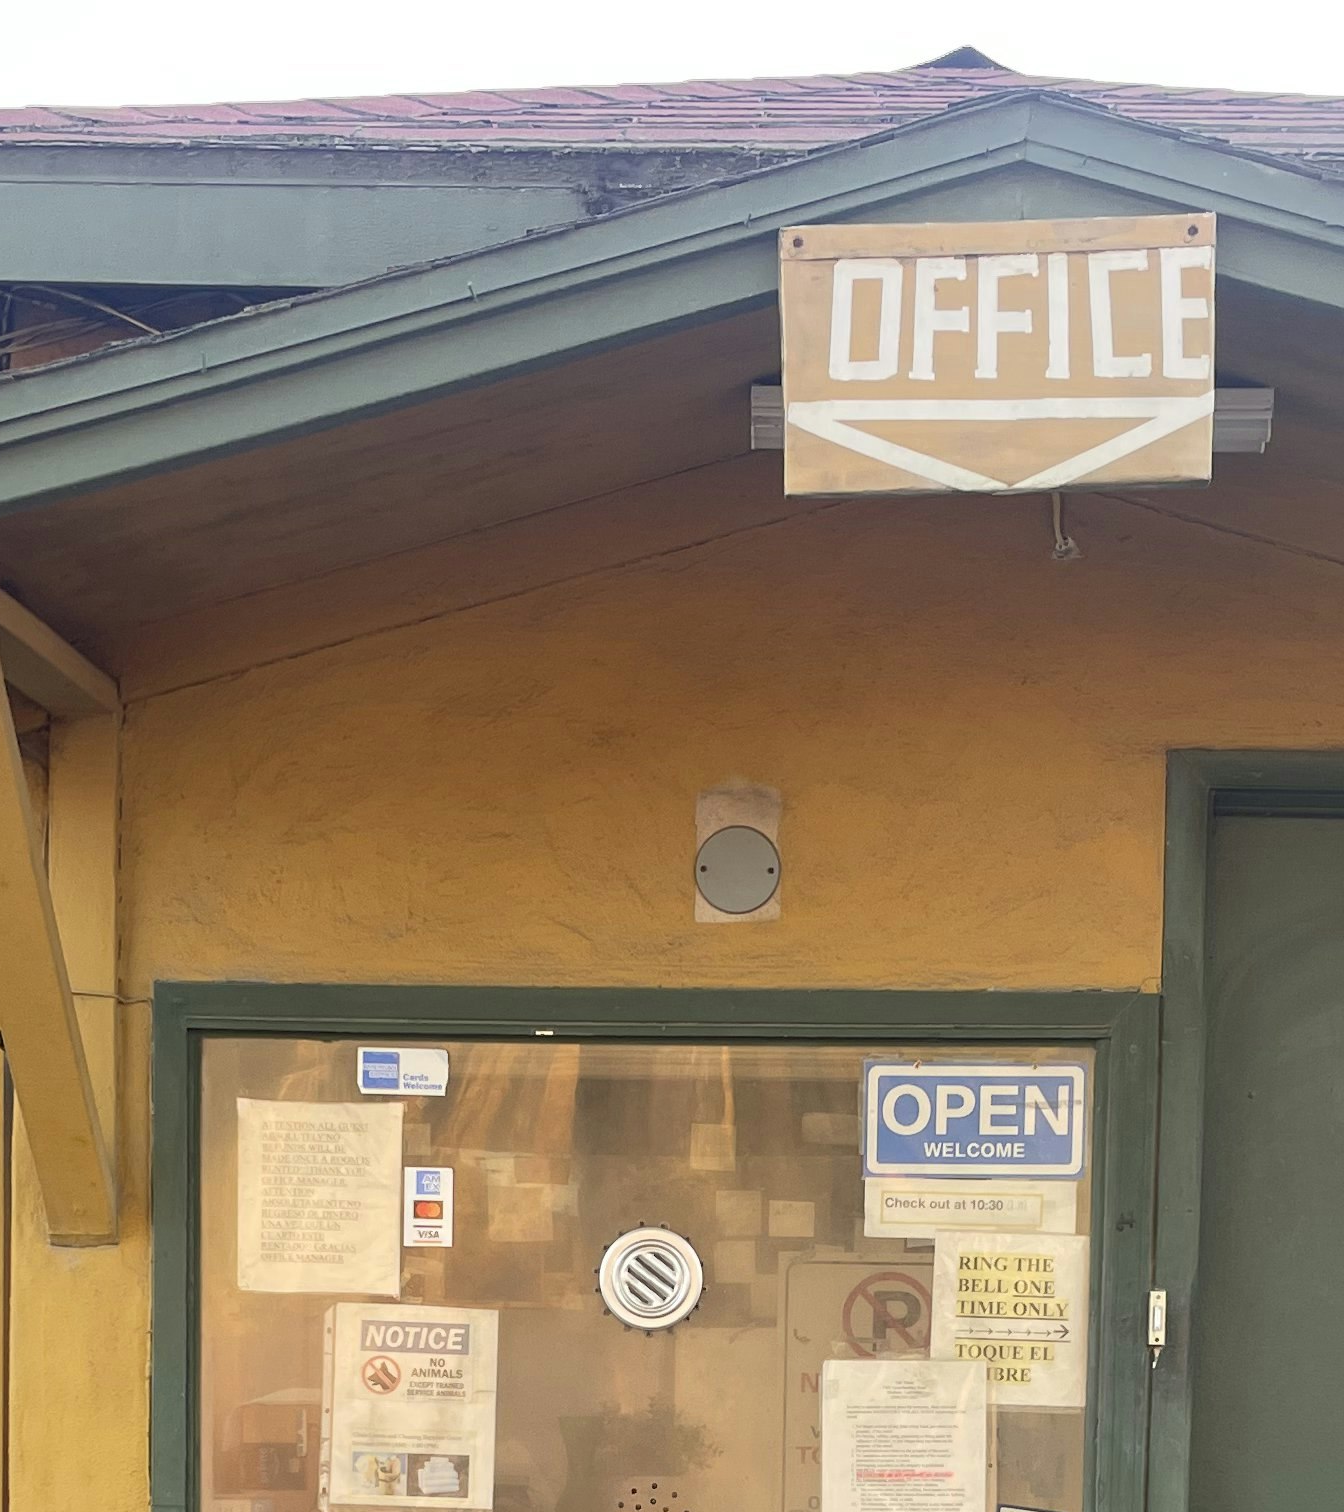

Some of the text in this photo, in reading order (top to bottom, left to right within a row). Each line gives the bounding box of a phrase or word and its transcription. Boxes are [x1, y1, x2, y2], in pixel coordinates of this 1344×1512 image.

[828, 245, 1213, 381] OFFICE
[403, 1073, 429, 1082] Cards
[403, 1082, 443, 1091] Welcome
[882, 1084, 1070, 1136] OPEN
[923, 1142, 1025, 1158] WELCOME
[423, 1175, 440, 1183] AM
[424, 1183, 441, 1192] EX
[885, 1197, 926, 1210] Check
[929, 1199, 950, 1210] out
[954, 1199, 967, 1211] at
[971, 1200, 1004, 1212] 10:30
[417, 1230, 440, 1239] VISA
[958, 1256, 1054, 1273] RING THE
[958, 1278, 1055, 1297] BELL ONE
[956, 1299, 1070, 1319] TIME ONLY
[365, 1325, 466, 1351] NOTICE
[954, 1343, 1055, 1362] TOQUE EL
[429, 1358, 446, 1368] NO
[411, 1368, 464, 1379] ANIMALS
